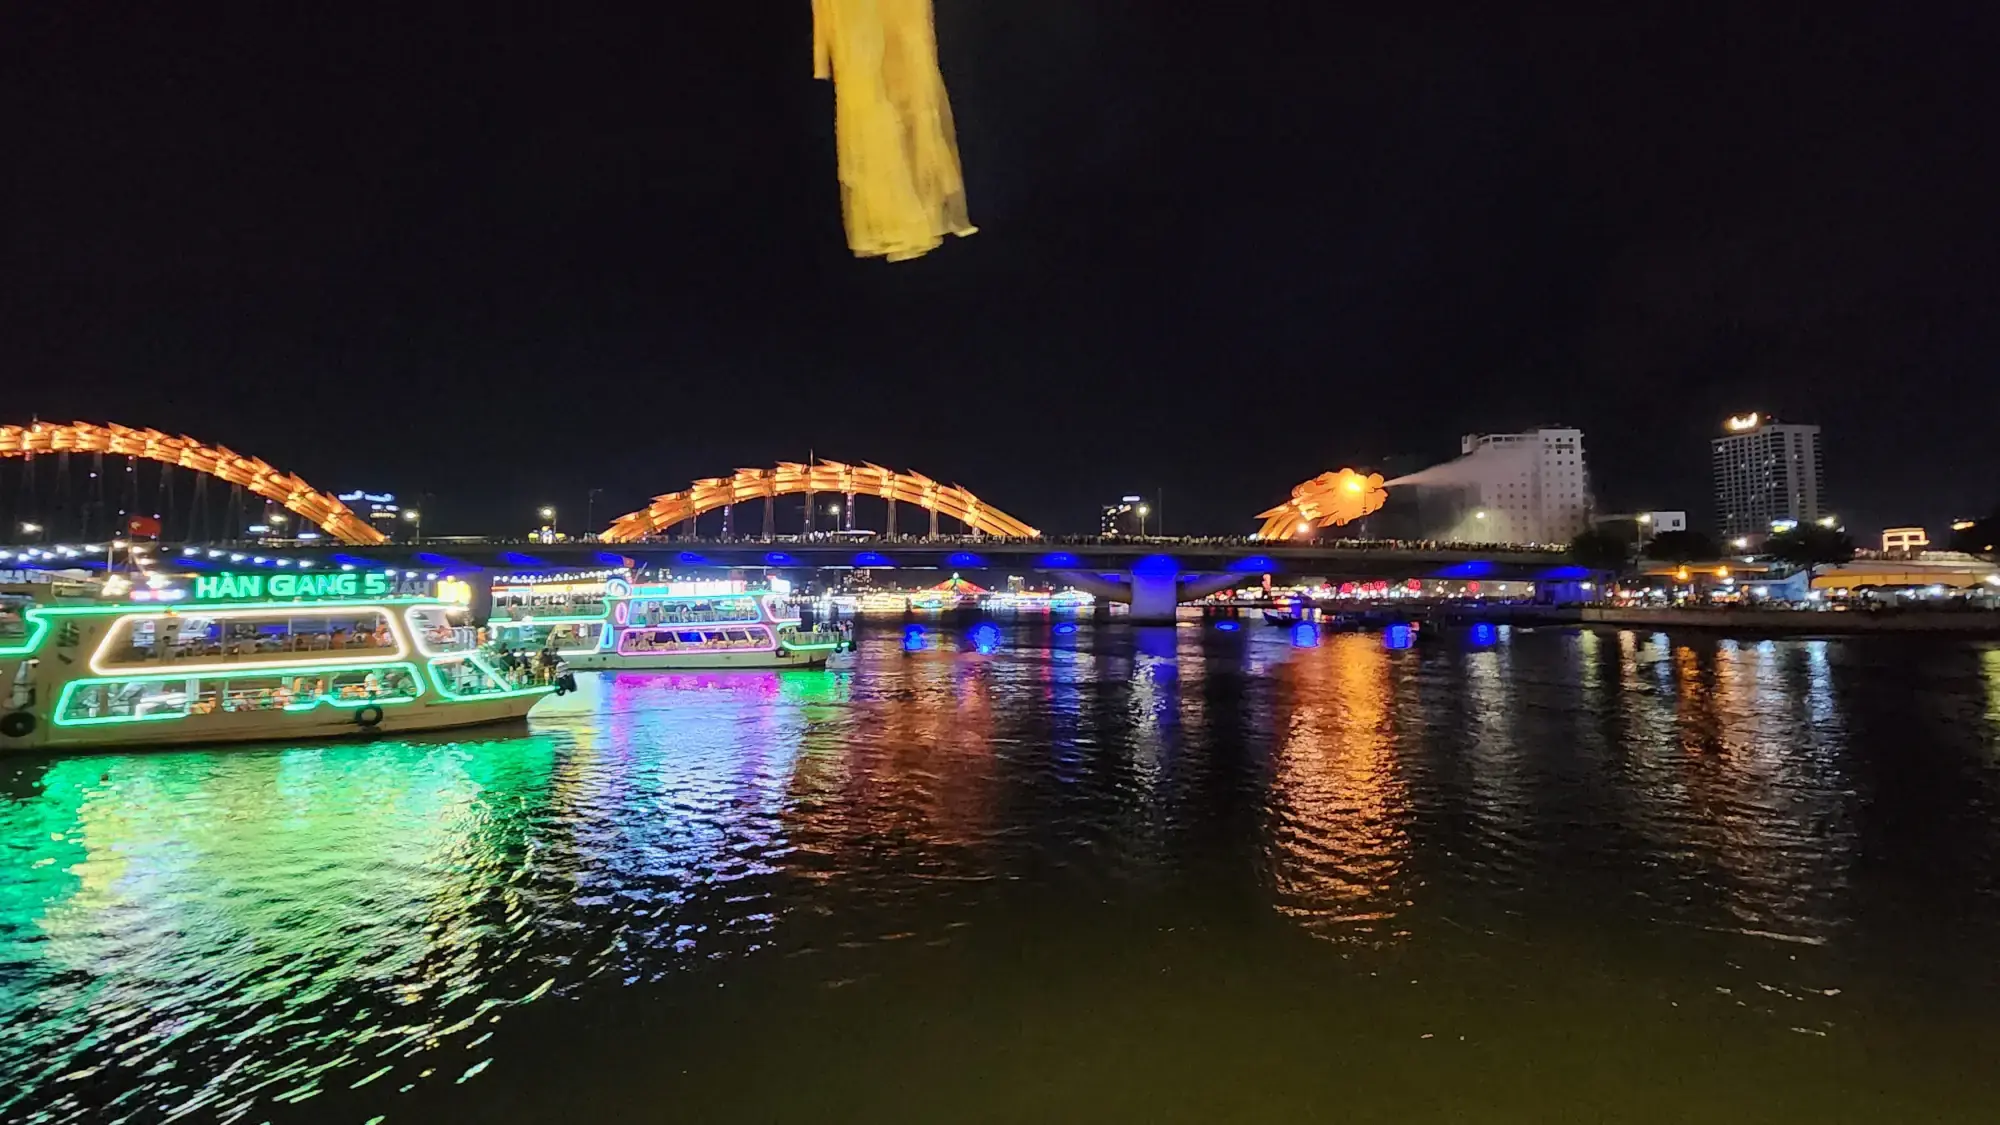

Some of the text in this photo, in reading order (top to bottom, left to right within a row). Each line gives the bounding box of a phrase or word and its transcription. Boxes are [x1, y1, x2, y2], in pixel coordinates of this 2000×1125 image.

[195, 571, 261, 598] HÀN
[269, 574, 357, 596] GIANG
[364, 573, 386, 594] 5
